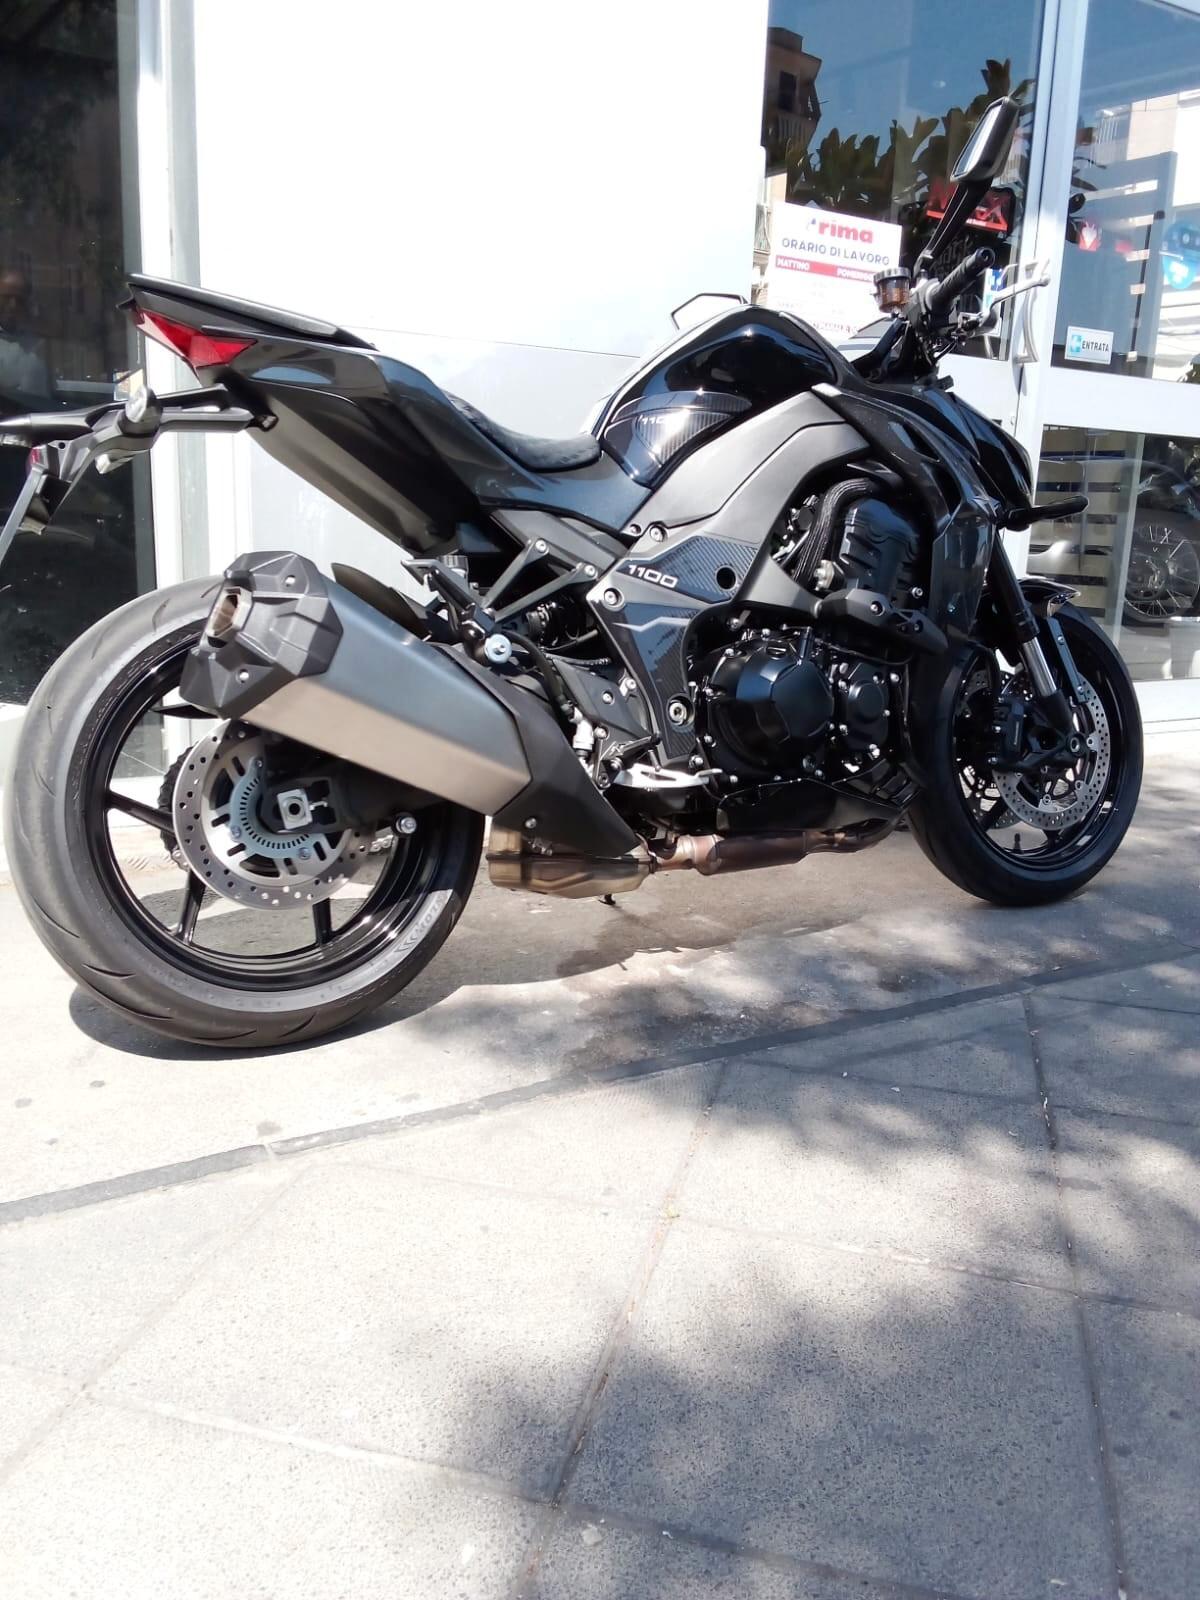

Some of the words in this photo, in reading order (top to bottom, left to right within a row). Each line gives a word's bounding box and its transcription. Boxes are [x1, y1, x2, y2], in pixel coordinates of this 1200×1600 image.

[782, 237, 827, 254] ORARIO
[830, 246, 841, 257] DI
[844, 248, 890, 266] LAVORO
[777, 258, 810, 270] MATTINO
[1082, 340, 1109, 352] ENTRATA
[628, 565, 678, 587] 1100
